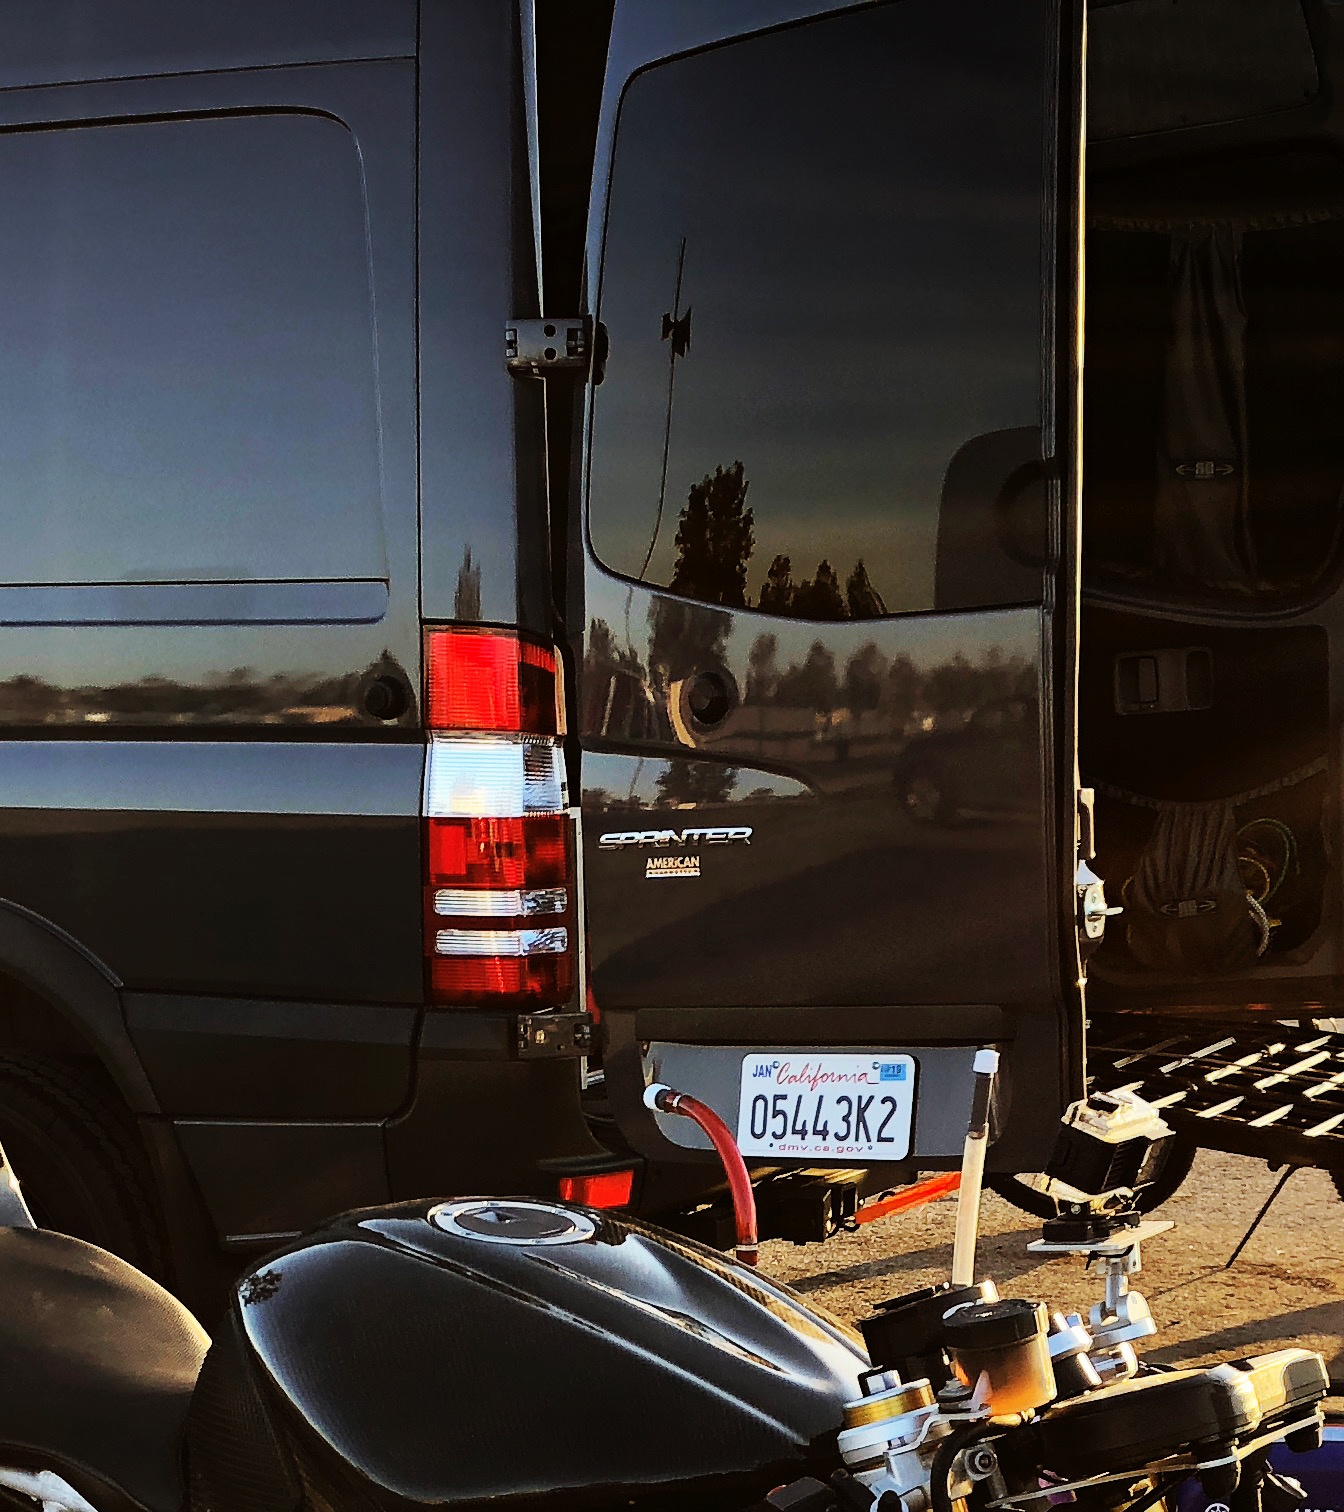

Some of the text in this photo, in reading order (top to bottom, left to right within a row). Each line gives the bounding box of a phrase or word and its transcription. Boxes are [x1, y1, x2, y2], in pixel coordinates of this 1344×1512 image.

[599, 826, 753, 850] SPRINTER
[646, 856, 700, 869] AMERICAN
[752, 1065, 772, 1078] JAN
[776, 1062, 879, 1091] California
[750, 1094, 898, 1143] 05443K2
[778, 1143, 864, 1153] dmv.ca.gov
